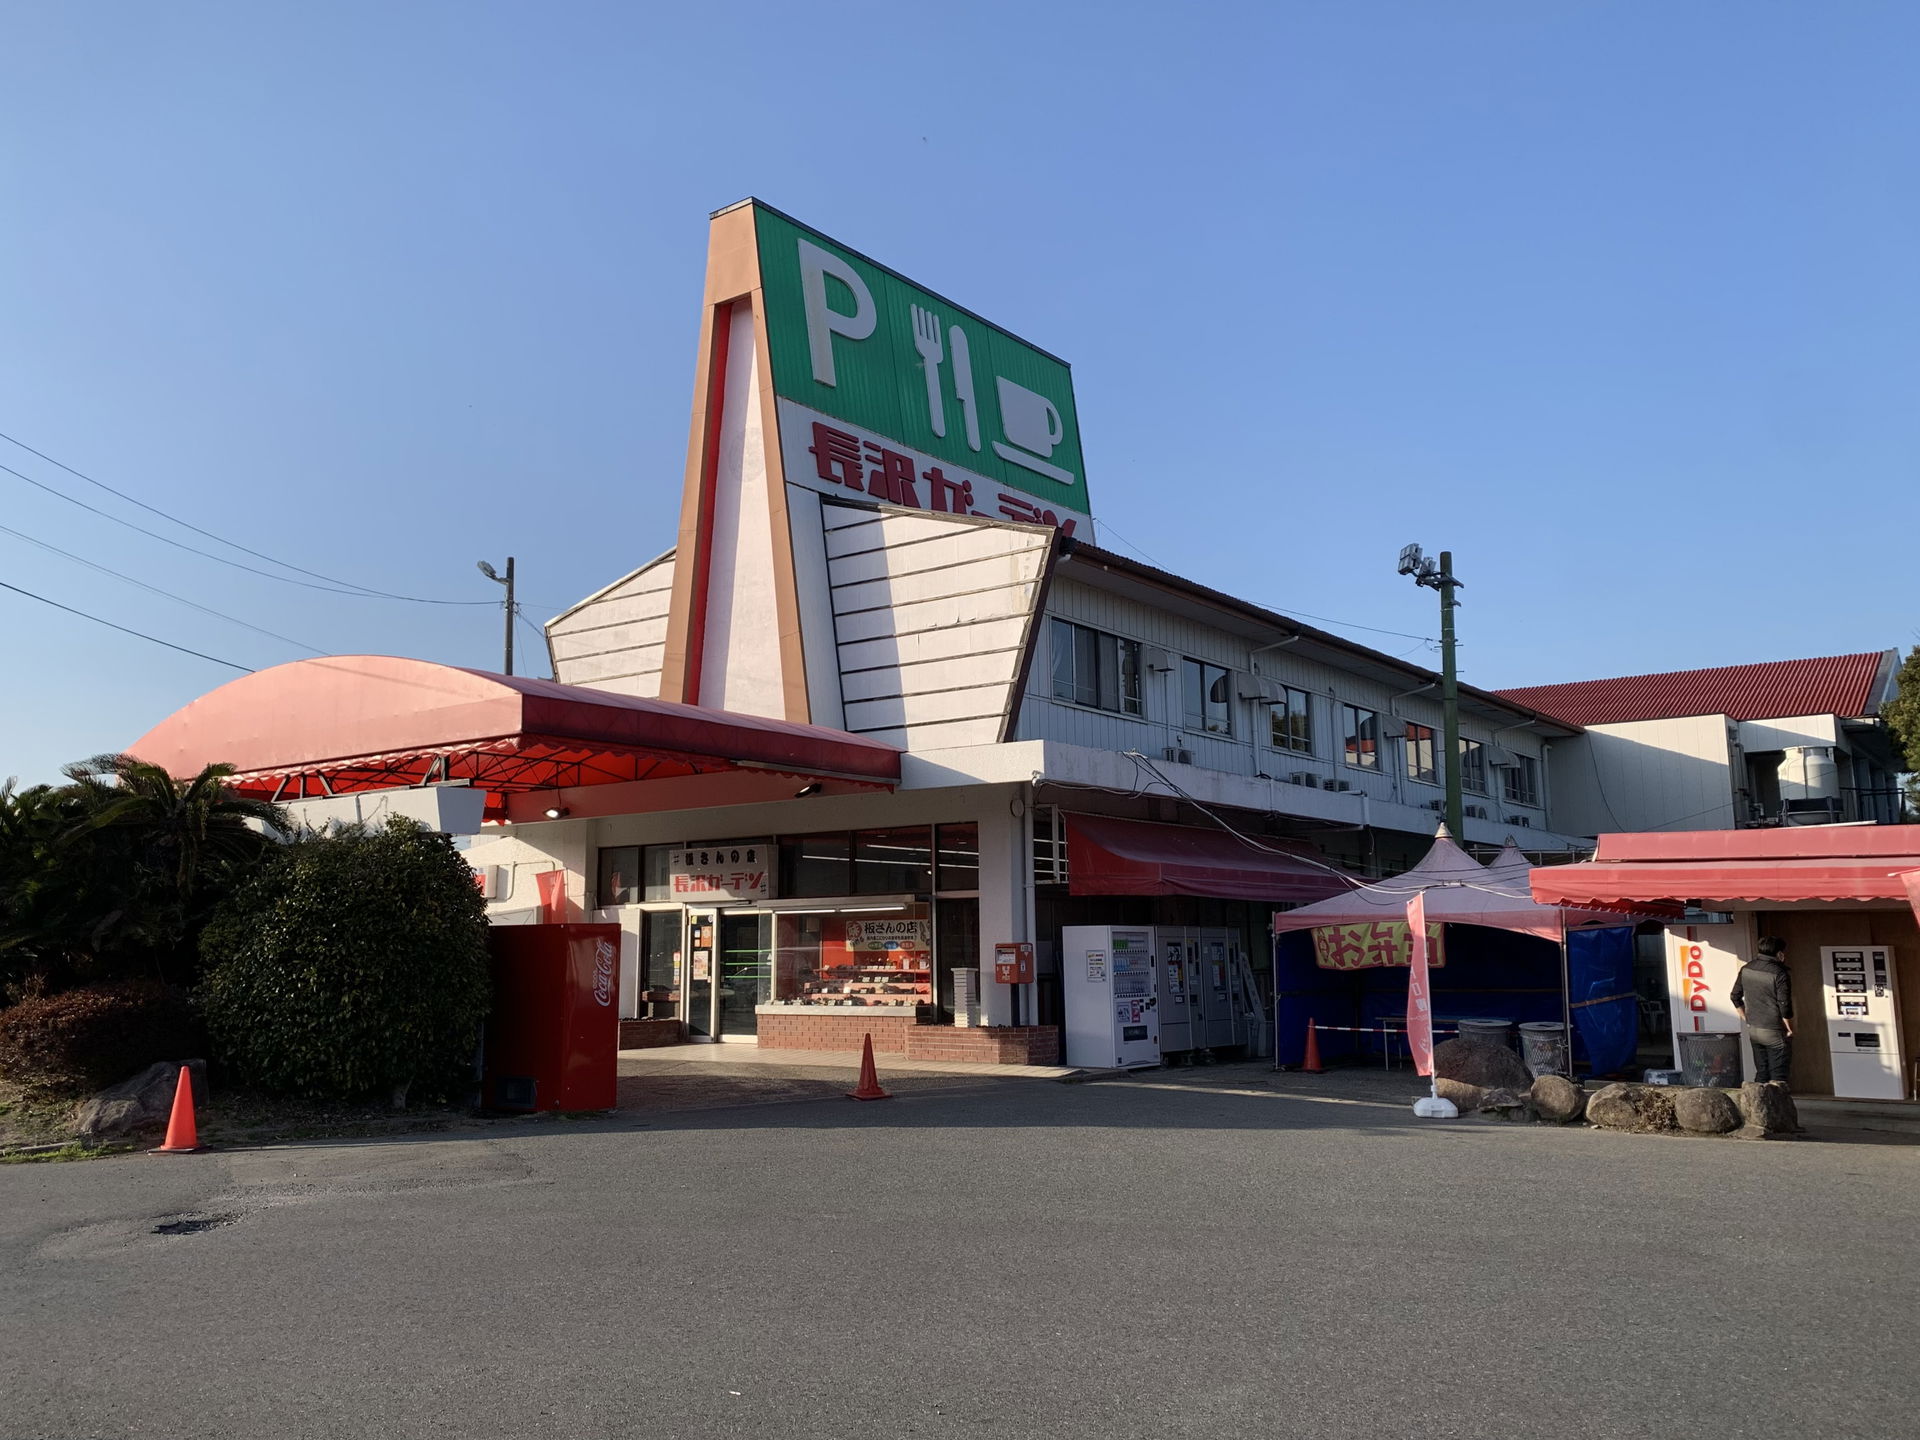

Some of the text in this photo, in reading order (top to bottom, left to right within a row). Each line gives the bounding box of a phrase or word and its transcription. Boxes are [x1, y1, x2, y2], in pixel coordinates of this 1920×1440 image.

[798, 238, 877, 387] P
[673, 872, 764, 893] 長沢ガーデン
[864, 922, 918, 934] 板さんの店
[1327, 922, 1438, 967] お弁当
[593, 937, 613, 1007] Coca-Cola
[1687, 945, 1710, 1012] DyDo
